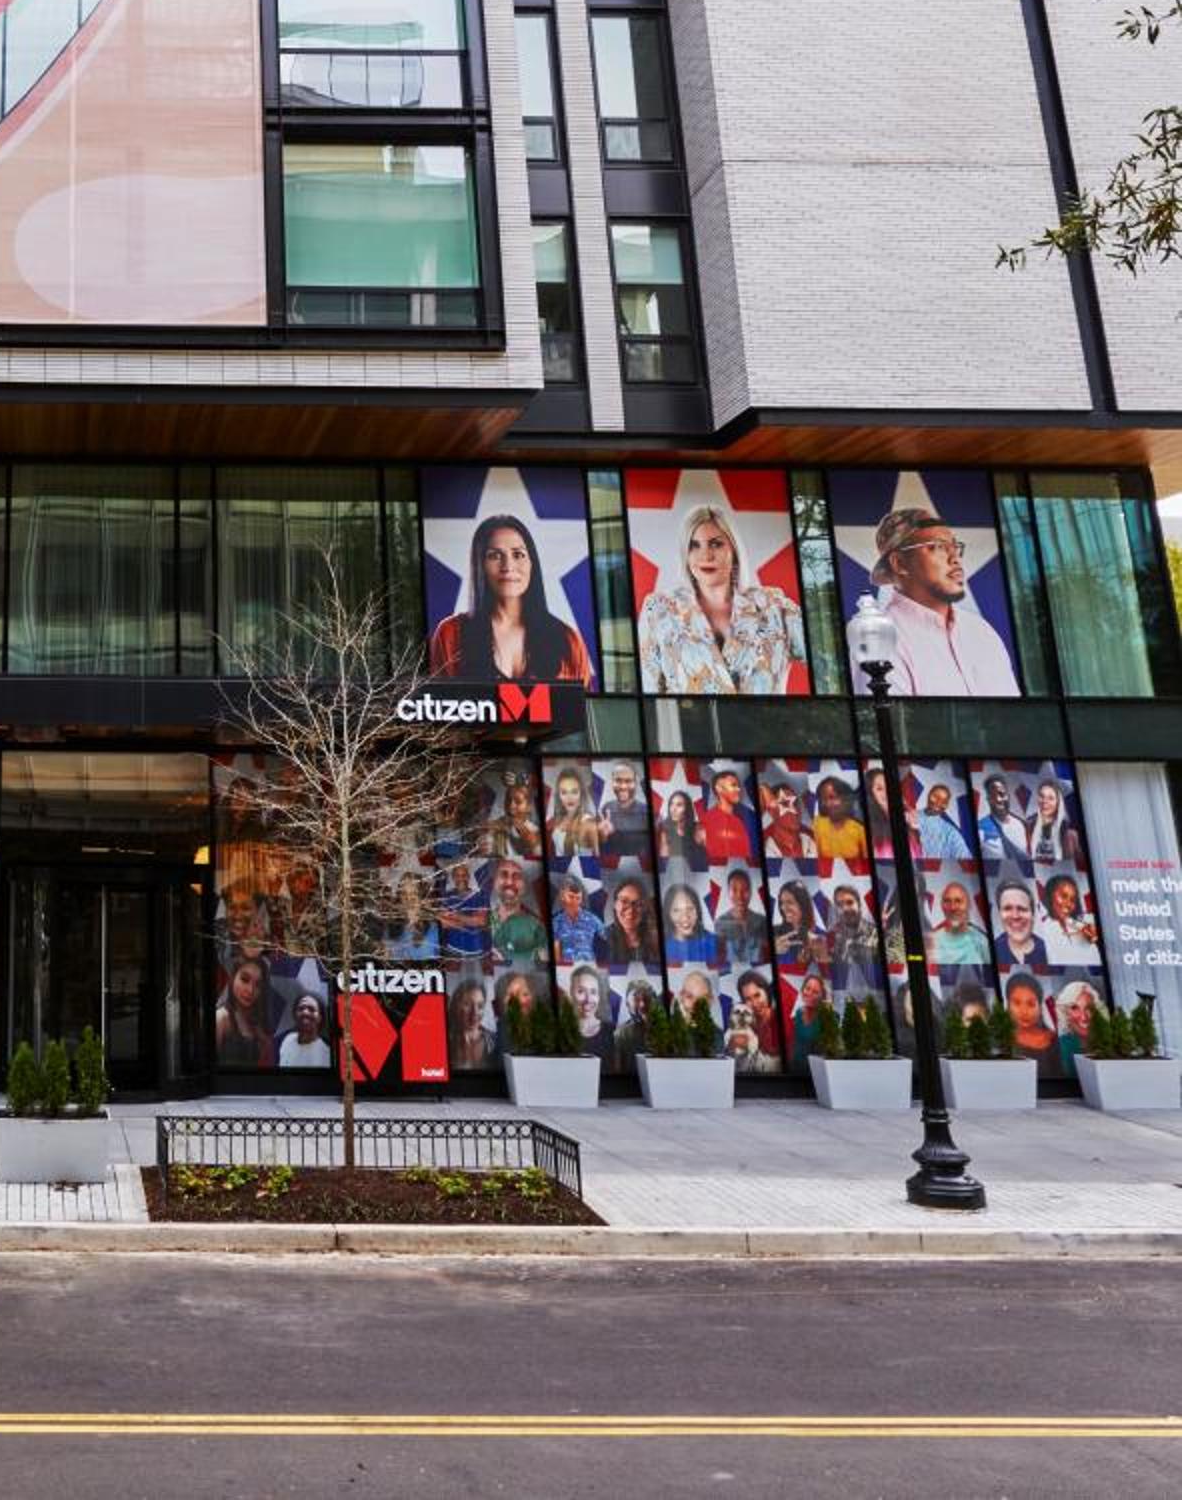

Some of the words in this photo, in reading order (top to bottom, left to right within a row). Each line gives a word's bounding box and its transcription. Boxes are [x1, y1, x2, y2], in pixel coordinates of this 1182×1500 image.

[1111, 879, 1157, 893] meet
[1114, 900, 1172, 917] United
[1119, 924, 1175, 941] States
[1123, 950, 1140, 965] of
[337, 961, 445, 993] citizen
